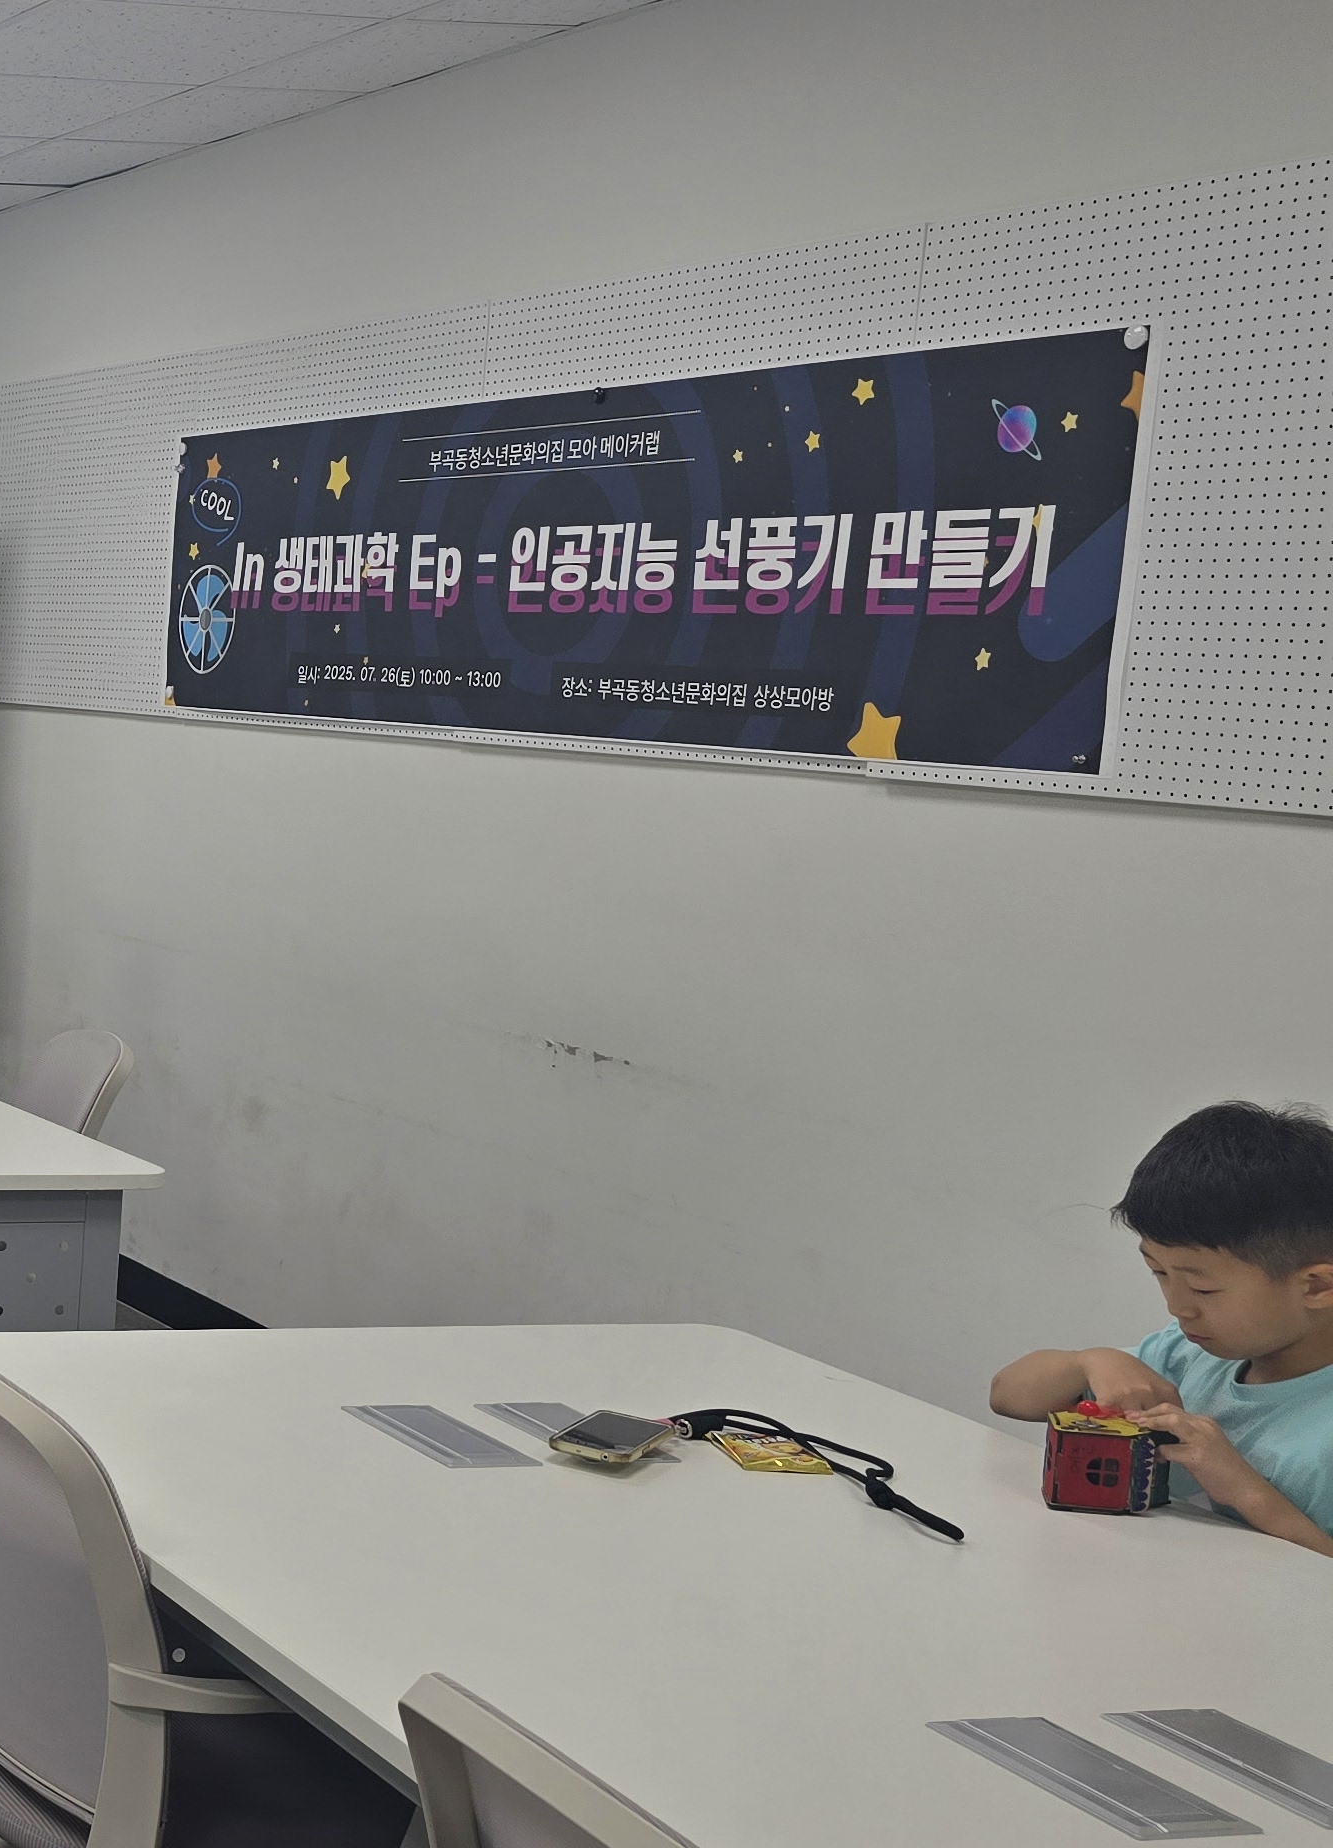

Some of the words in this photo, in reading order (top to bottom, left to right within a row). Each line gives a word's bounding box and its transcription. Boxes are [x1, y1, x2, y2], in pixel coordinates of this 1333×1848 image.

[428, 438, 565, 473] 부곡동청소년문화의집
[566, 435, 598, 460] 모아
[599, 430, 661, 459] 메이커랩
[200, 489, 235, 521] COOL
[233, 541, 265, 592] In
[273, 531, 399, 594] 생태과학
[409, 534, 462, 598] Ep
[508, 522, 678, 592] 인공지능
[693, 513, 854, 590] 선풍기
[866, 504, 1057, 590] 만들기
[297, 665, 321, 685] 일시:
[323, 664, 356, 681] 2025.
[360, 666, 377, 682] 07.
[380, 667, 416, 687] 26(토)
[419, 668, 451, 685] 10:00
[466, 670, 502, 687] 13:00
[561, 676, 593, 699] 장소:
[597, 678, 748, 708] 부곡동청소년문화의집
[753, 685, 835, 712] 상상모아방
